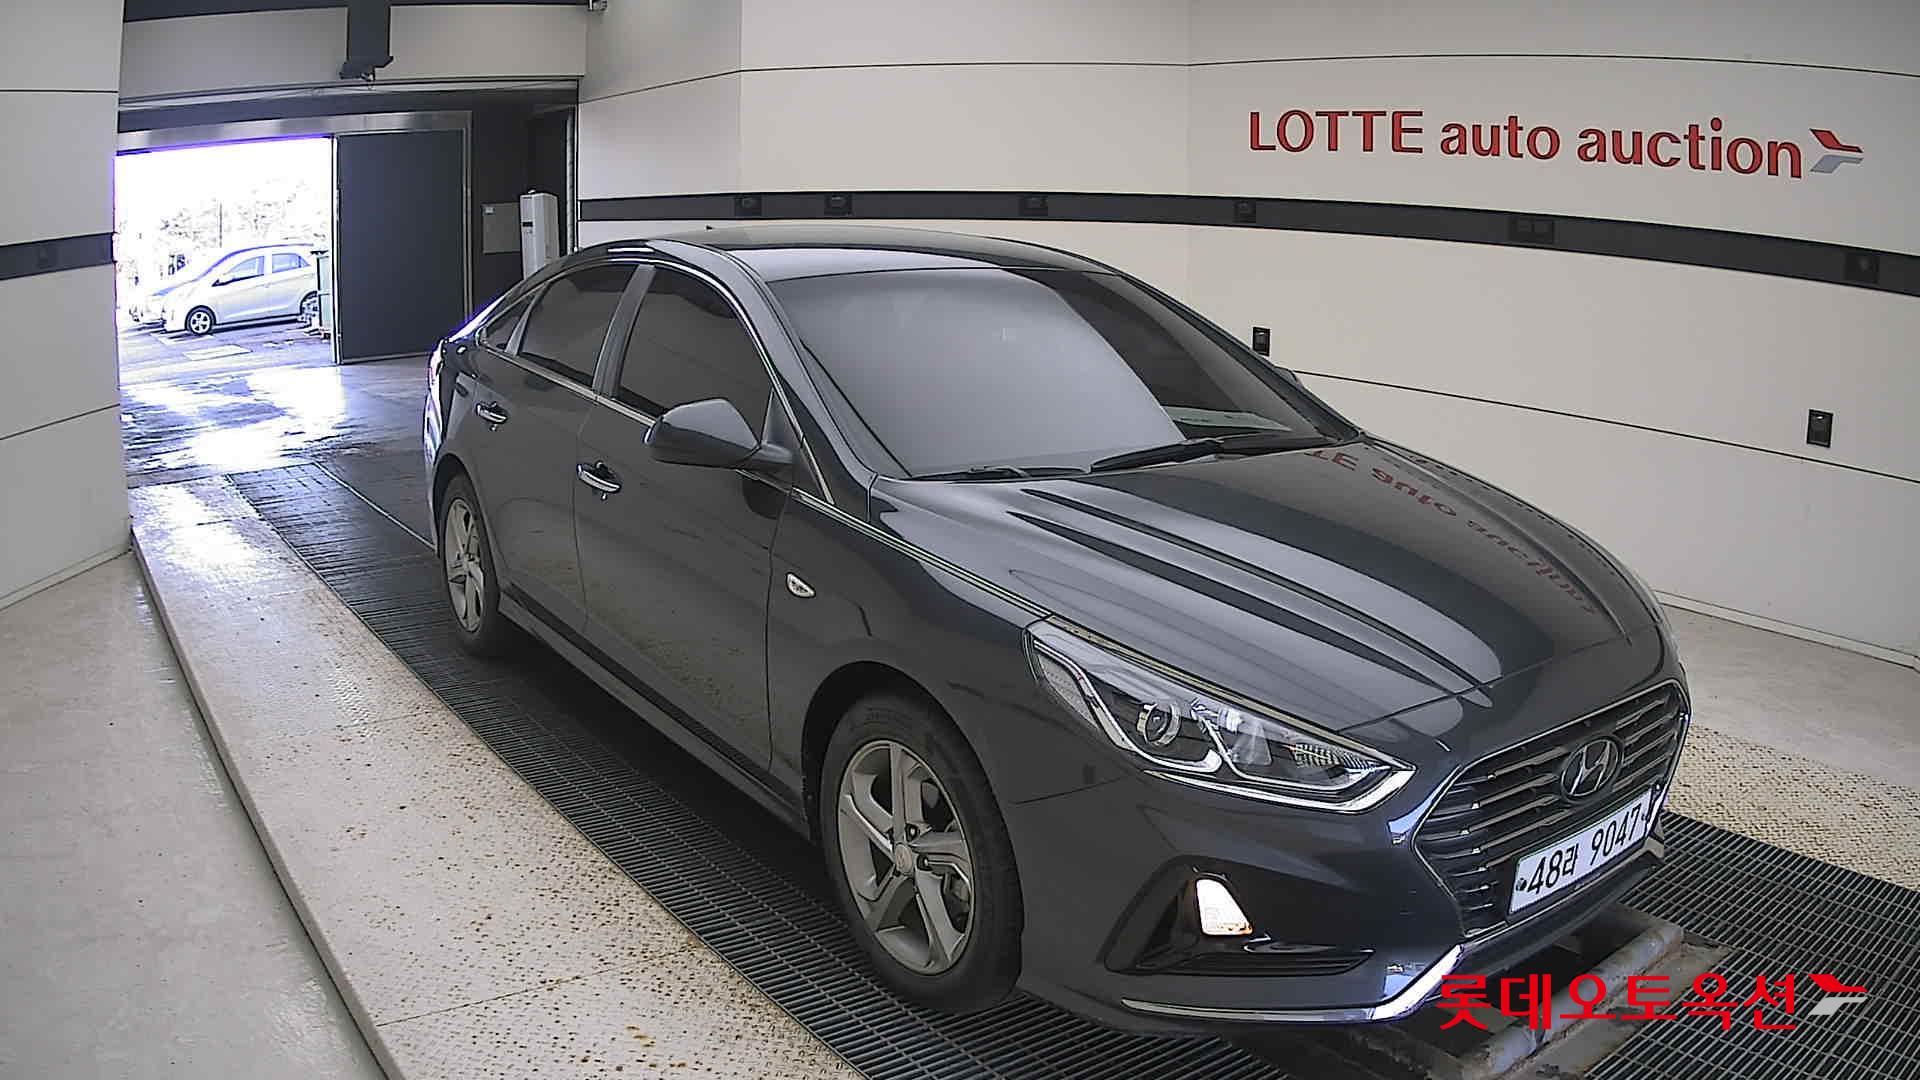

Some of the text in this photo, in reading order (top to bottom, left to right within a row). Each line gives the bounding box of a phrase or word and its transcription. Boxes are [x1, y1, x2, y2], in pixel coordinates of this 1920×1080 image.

[1248, 110, 1803, 179] LOTTE auto auction
[1589, 803, 1643, 866] 9047
